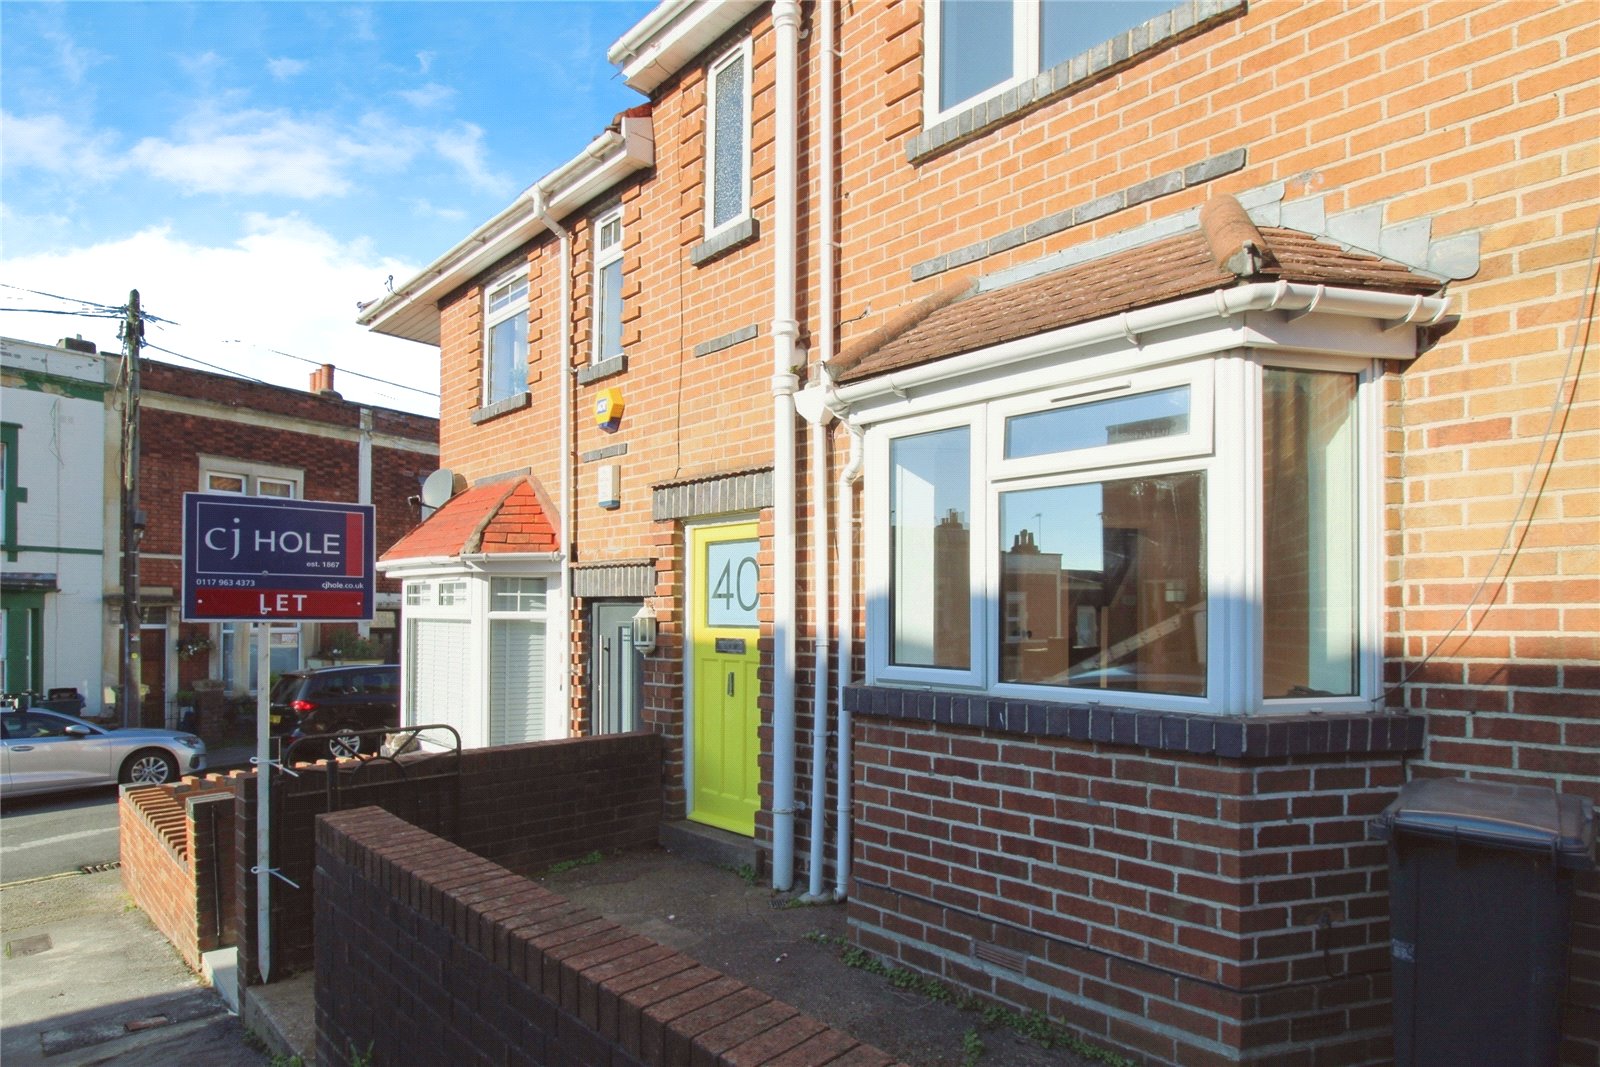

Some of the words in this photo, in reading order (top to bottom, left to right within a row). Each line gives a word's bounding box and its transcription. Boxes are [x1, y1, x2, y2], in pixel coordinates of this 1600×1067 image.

[254, 529, 341, 555] HOLE
[196, 578, 216, 586] 0117
[218, 578, 234, 587] 963
[235, 579, 256, 587] 4373
[321, 581, 364, 590] cjhole.co.uk
[711, 556, 760, 612] 40
[259, 593, 308, 612] LET
